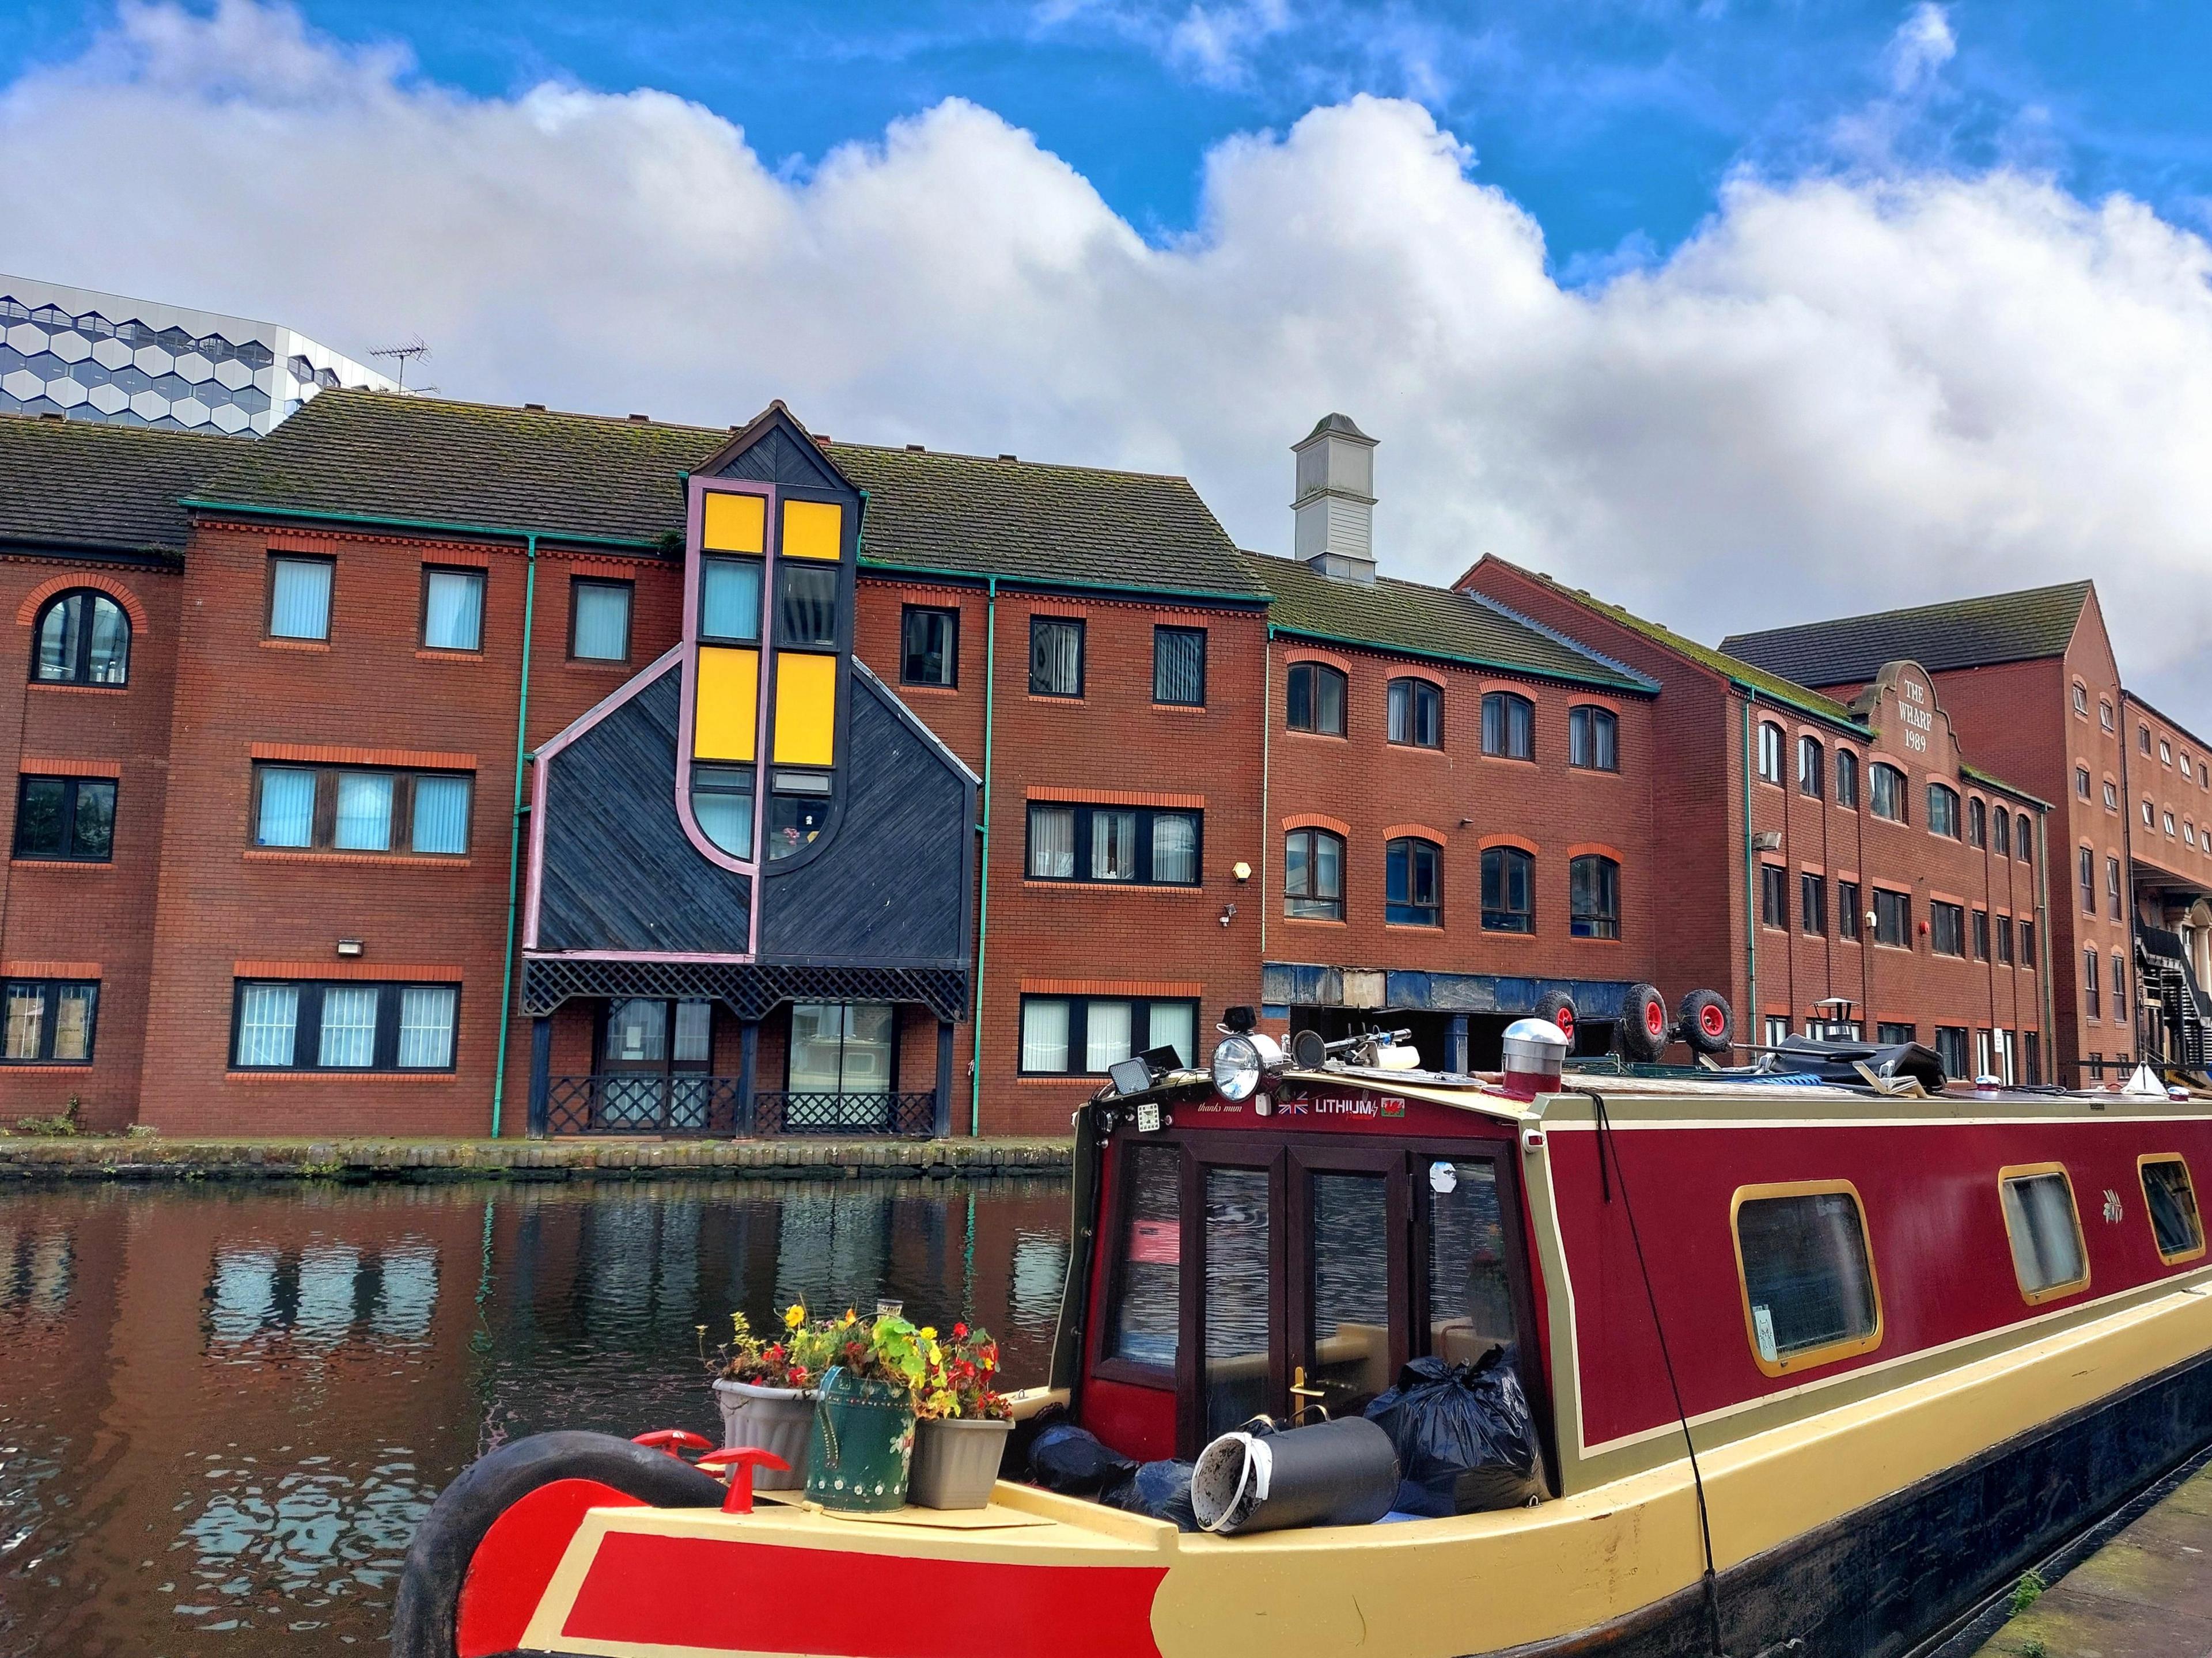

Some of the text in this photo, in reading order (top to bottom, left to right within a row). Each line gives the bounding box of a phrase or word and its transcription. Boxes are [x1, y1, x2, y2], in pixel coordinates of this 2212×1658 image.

[1904, 678, 1924, 705] THE
[1898, 700, 1932, 731] WHARF
[1904, 729, 1926, 753] 1989
[1198, 1102, 1221, 1112] thanks
[1316, 1099, 1371, 1114] LITHIUM
